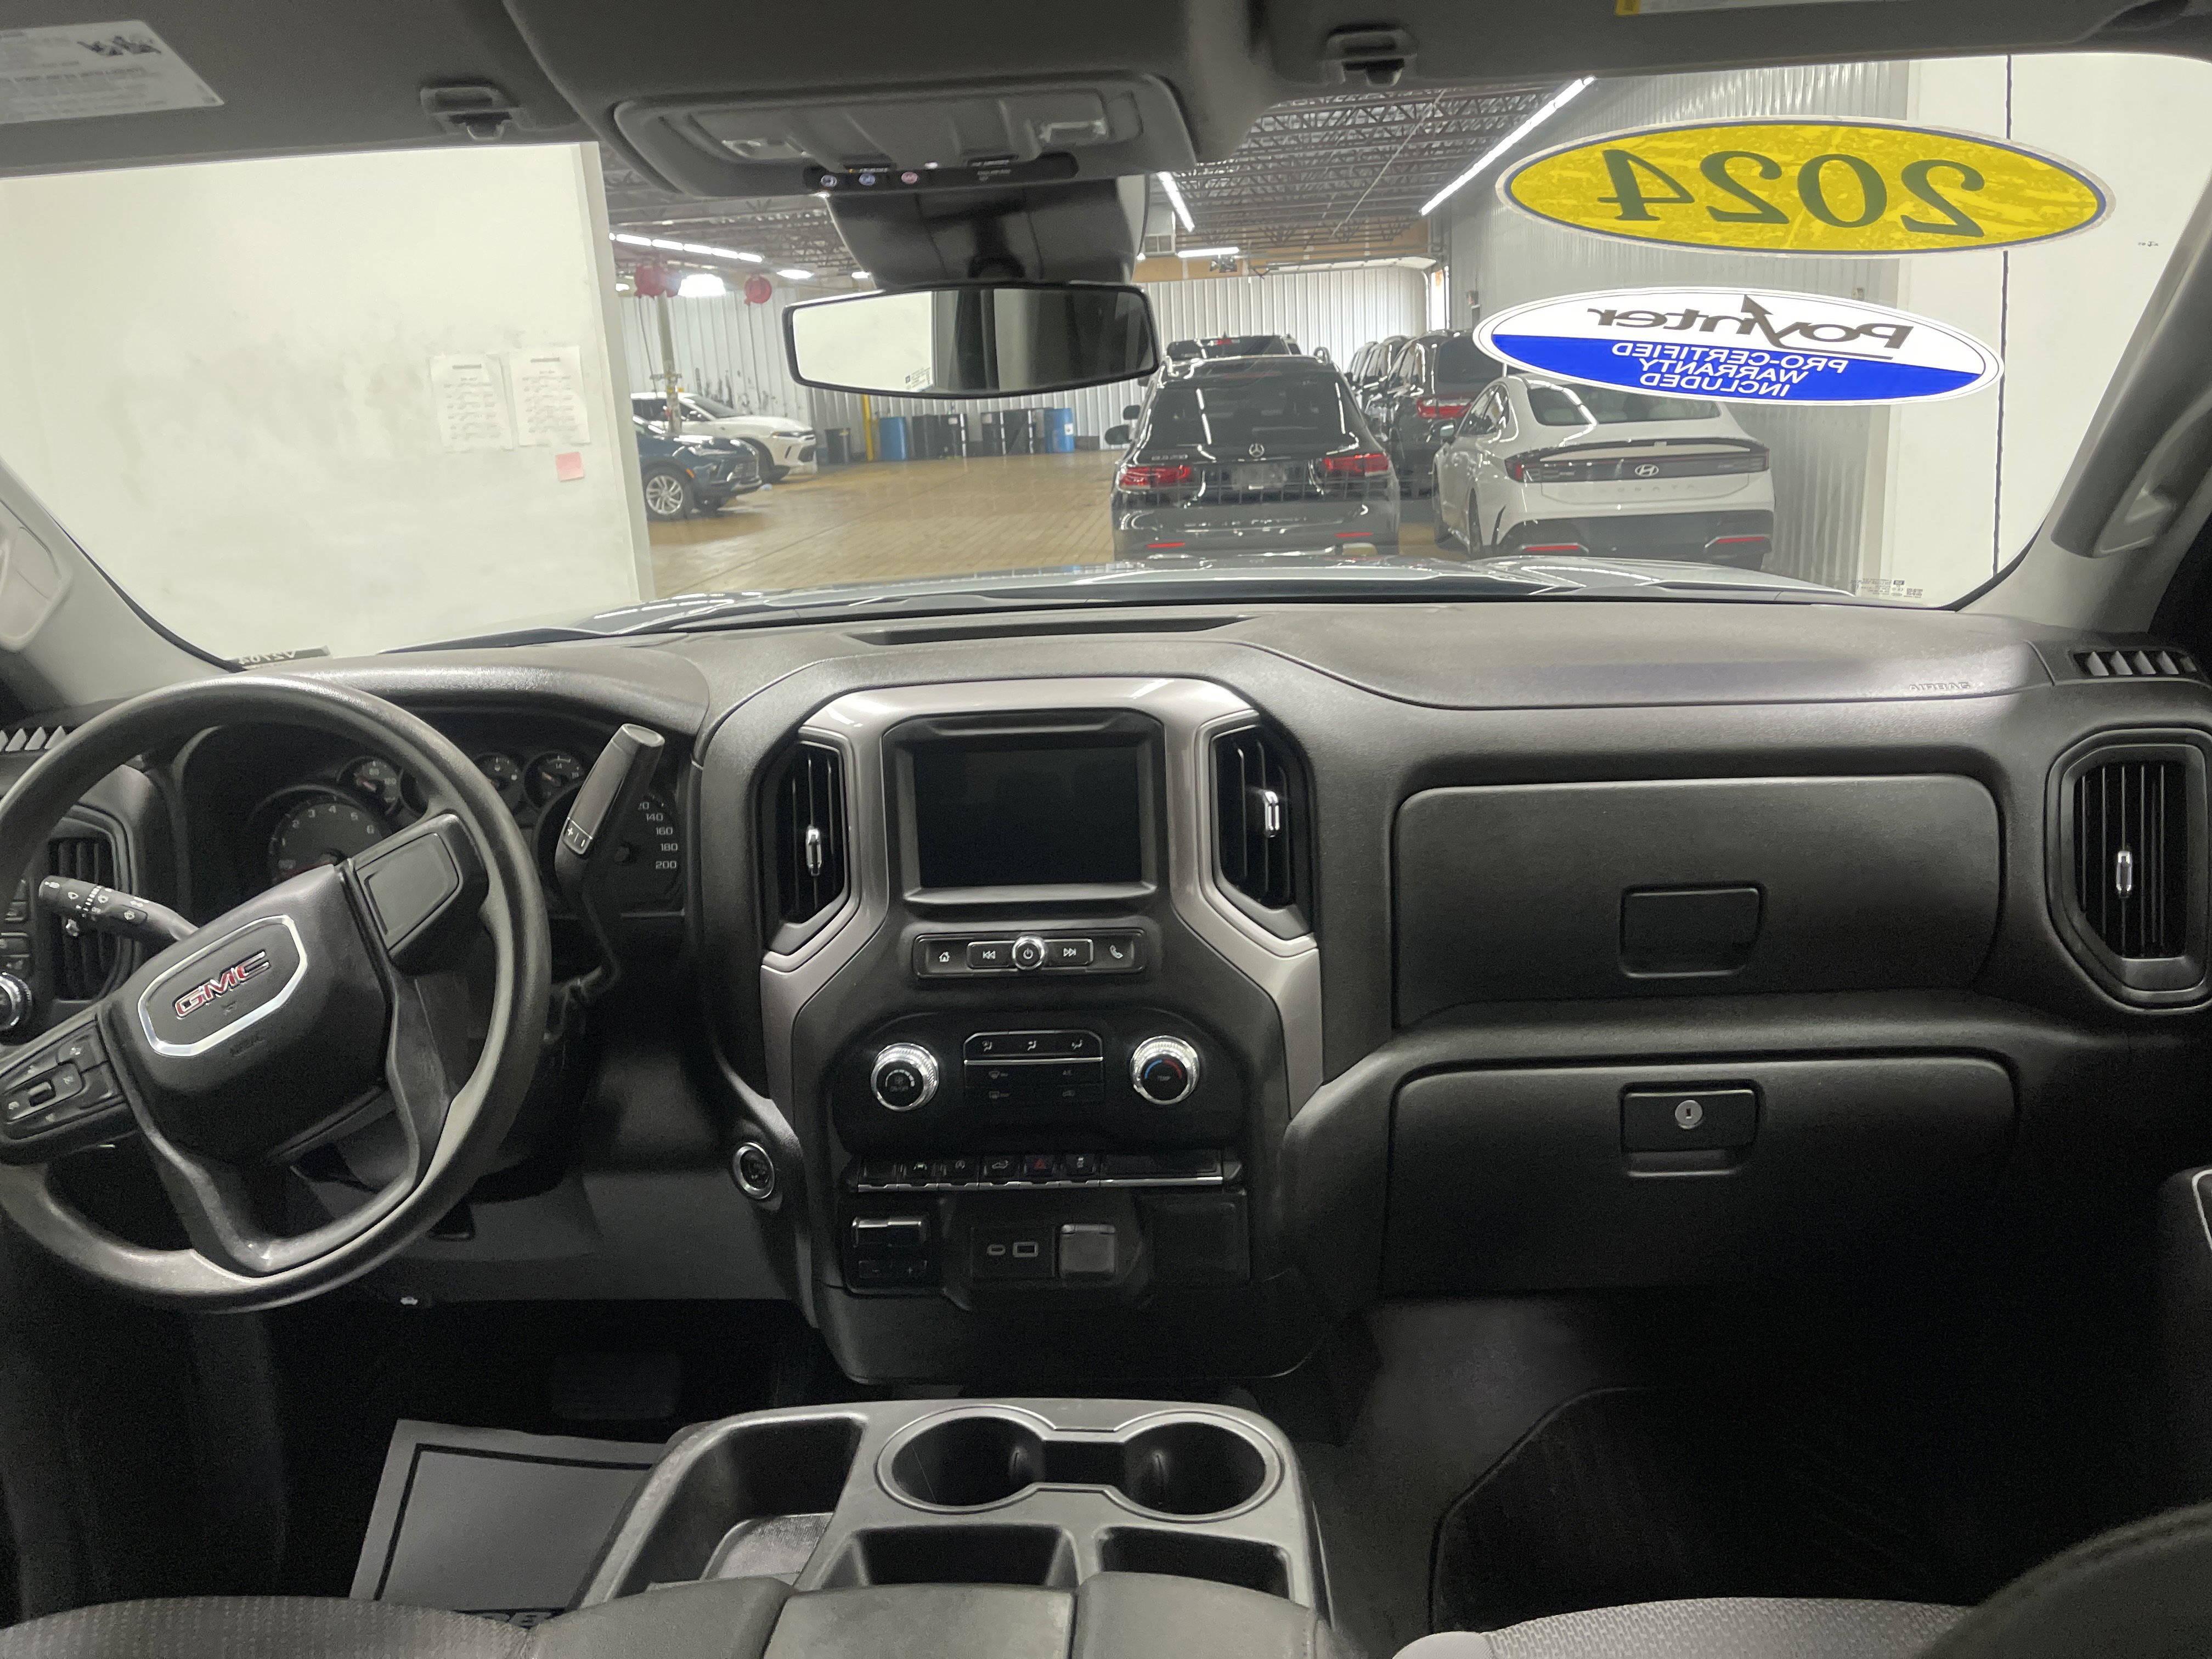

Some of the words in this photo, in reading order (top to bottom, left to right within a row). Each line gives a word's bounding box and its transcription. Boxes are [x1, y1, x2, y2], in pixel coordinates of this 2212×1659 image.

[1909, 681, 1971, 691] AIRBAG
[329, 805, 336, 814] 4
[646, 813, 664, 822] 140
[655, 826, 673, 836] 160
[660, 843, 678, 851] 180
[655, 860, 677, 870] 200
[174, 949, 272, 1018] GMC
